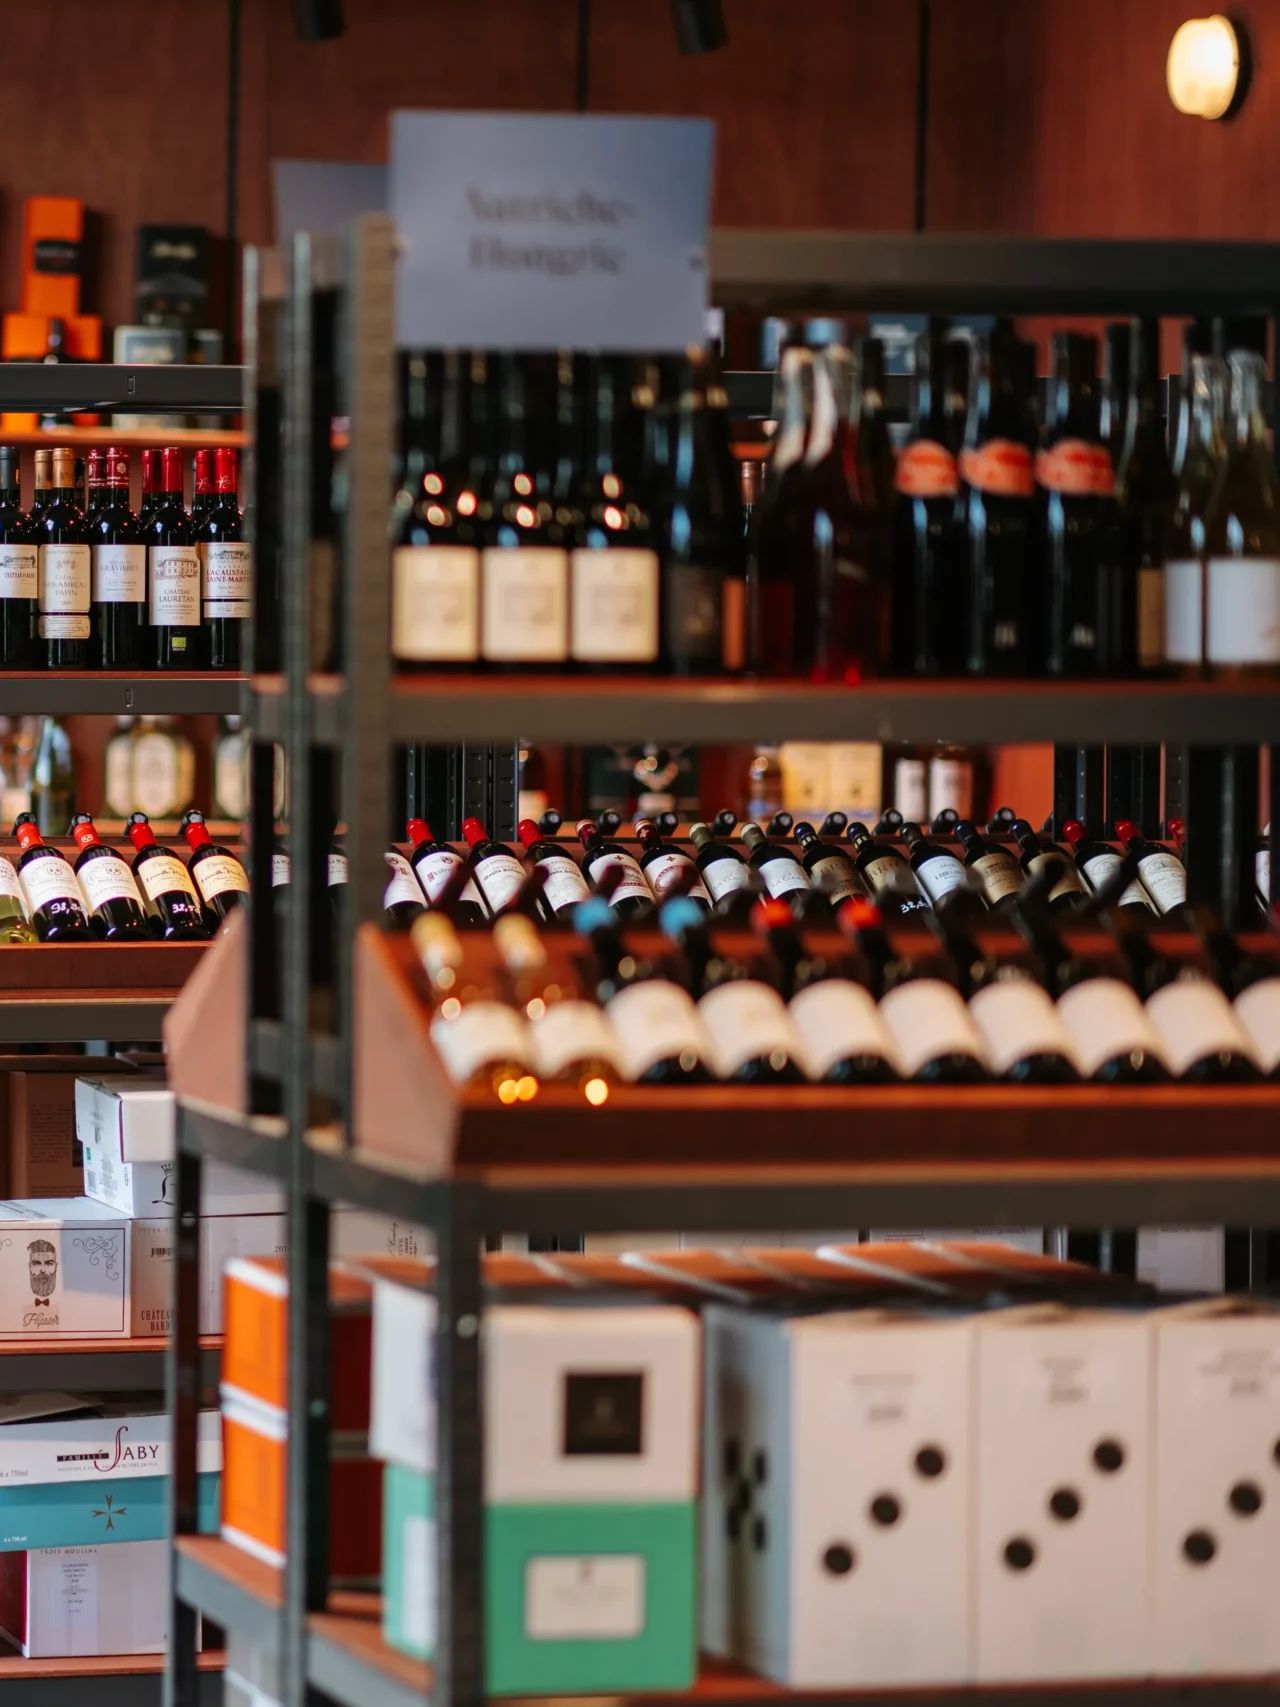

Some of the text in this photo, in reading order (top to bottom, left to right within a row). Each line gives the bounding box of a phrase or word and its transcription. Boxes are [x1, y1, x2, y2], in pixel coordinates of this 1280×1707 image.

[159, 595, 195, 603] LAURETAN
[274, 1245, 288, 1253] 201
[22, 1312, 60, 1329] Hipster
[150, 1321, 171, 1332] BARB
